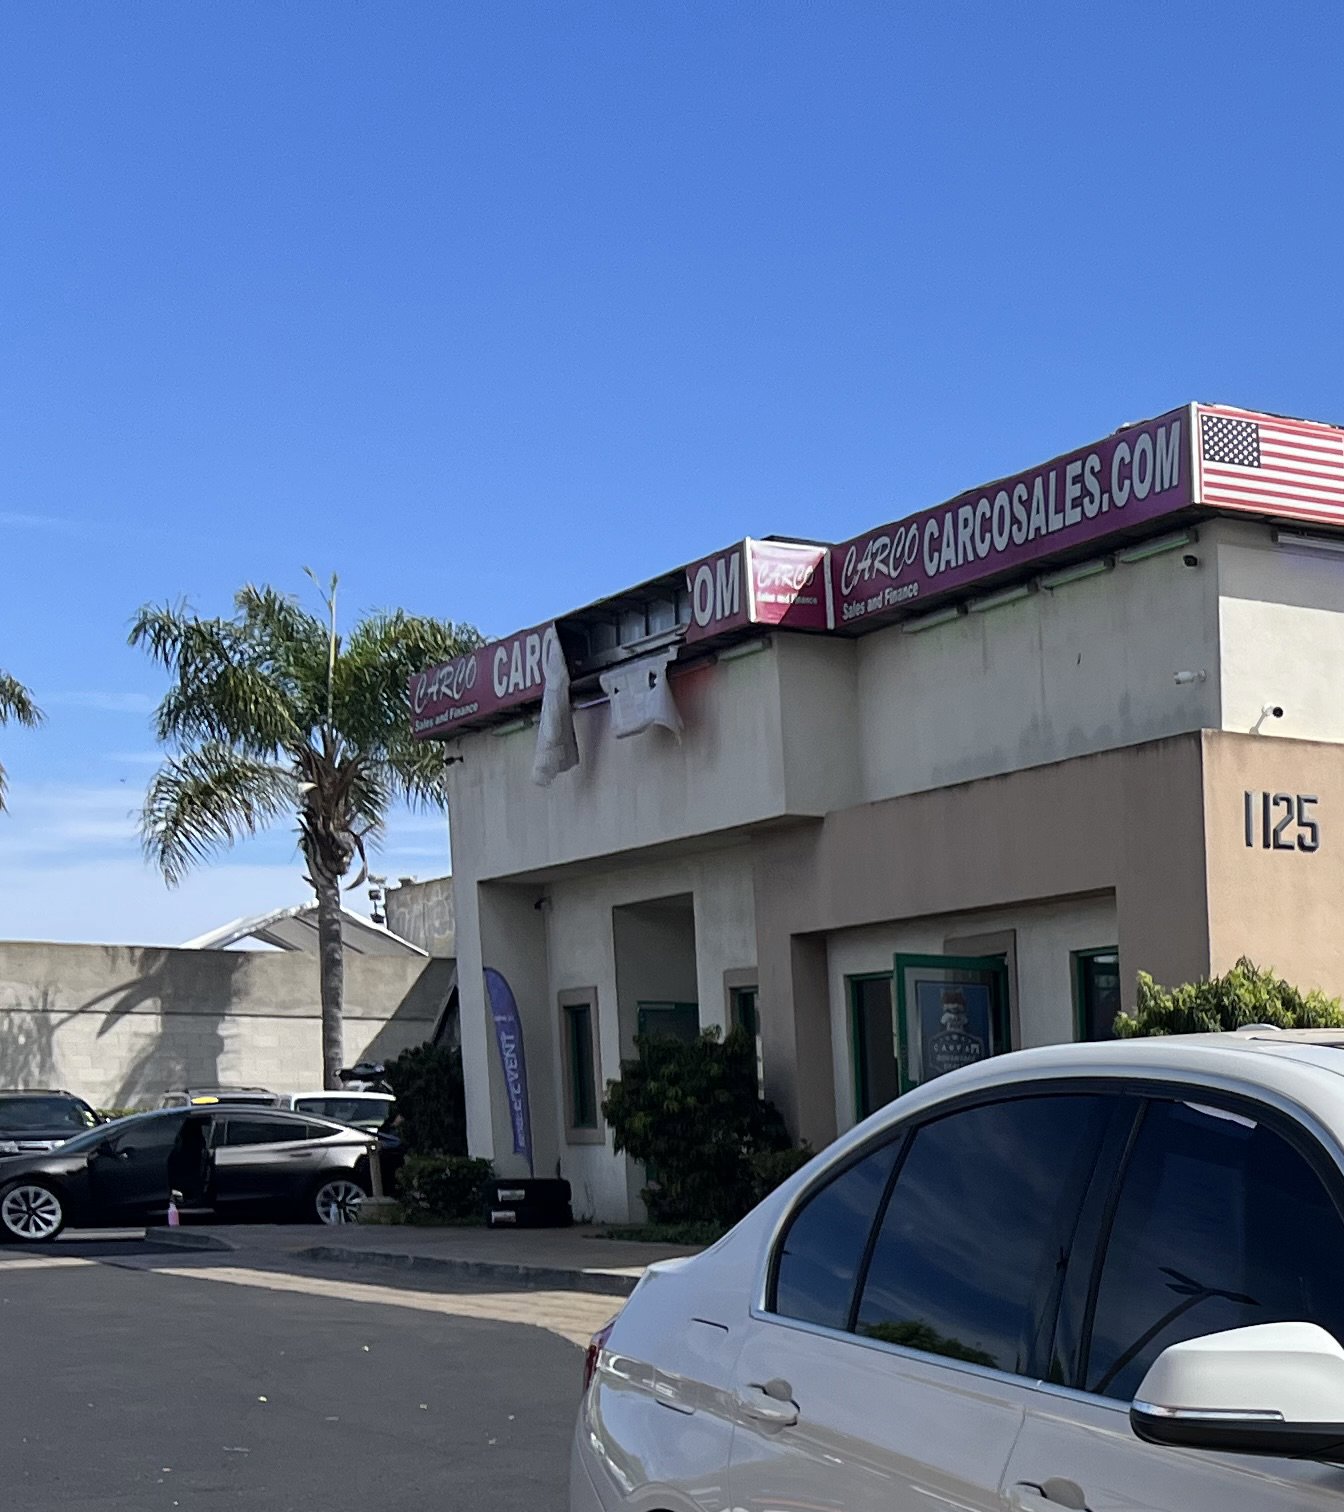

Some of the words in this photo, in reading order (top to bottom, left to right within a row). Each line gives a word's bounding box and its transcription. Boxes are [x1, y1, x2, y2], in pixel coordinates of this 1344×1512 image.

[841, 524, 919, 597] CARCO
[922, 419, 1183, 578] CARCOSALES.COM
[756, 562, 815, 591] CARCO
[842, 594, 866, 621] Sales
[866, 590, 884, 612] and
[884, 581, 919, 607] Finance
[414, 655, 477, 714] CARCO
[687, 552, 741, 628] OM
[1244, 790, 1320, 854] 1125
